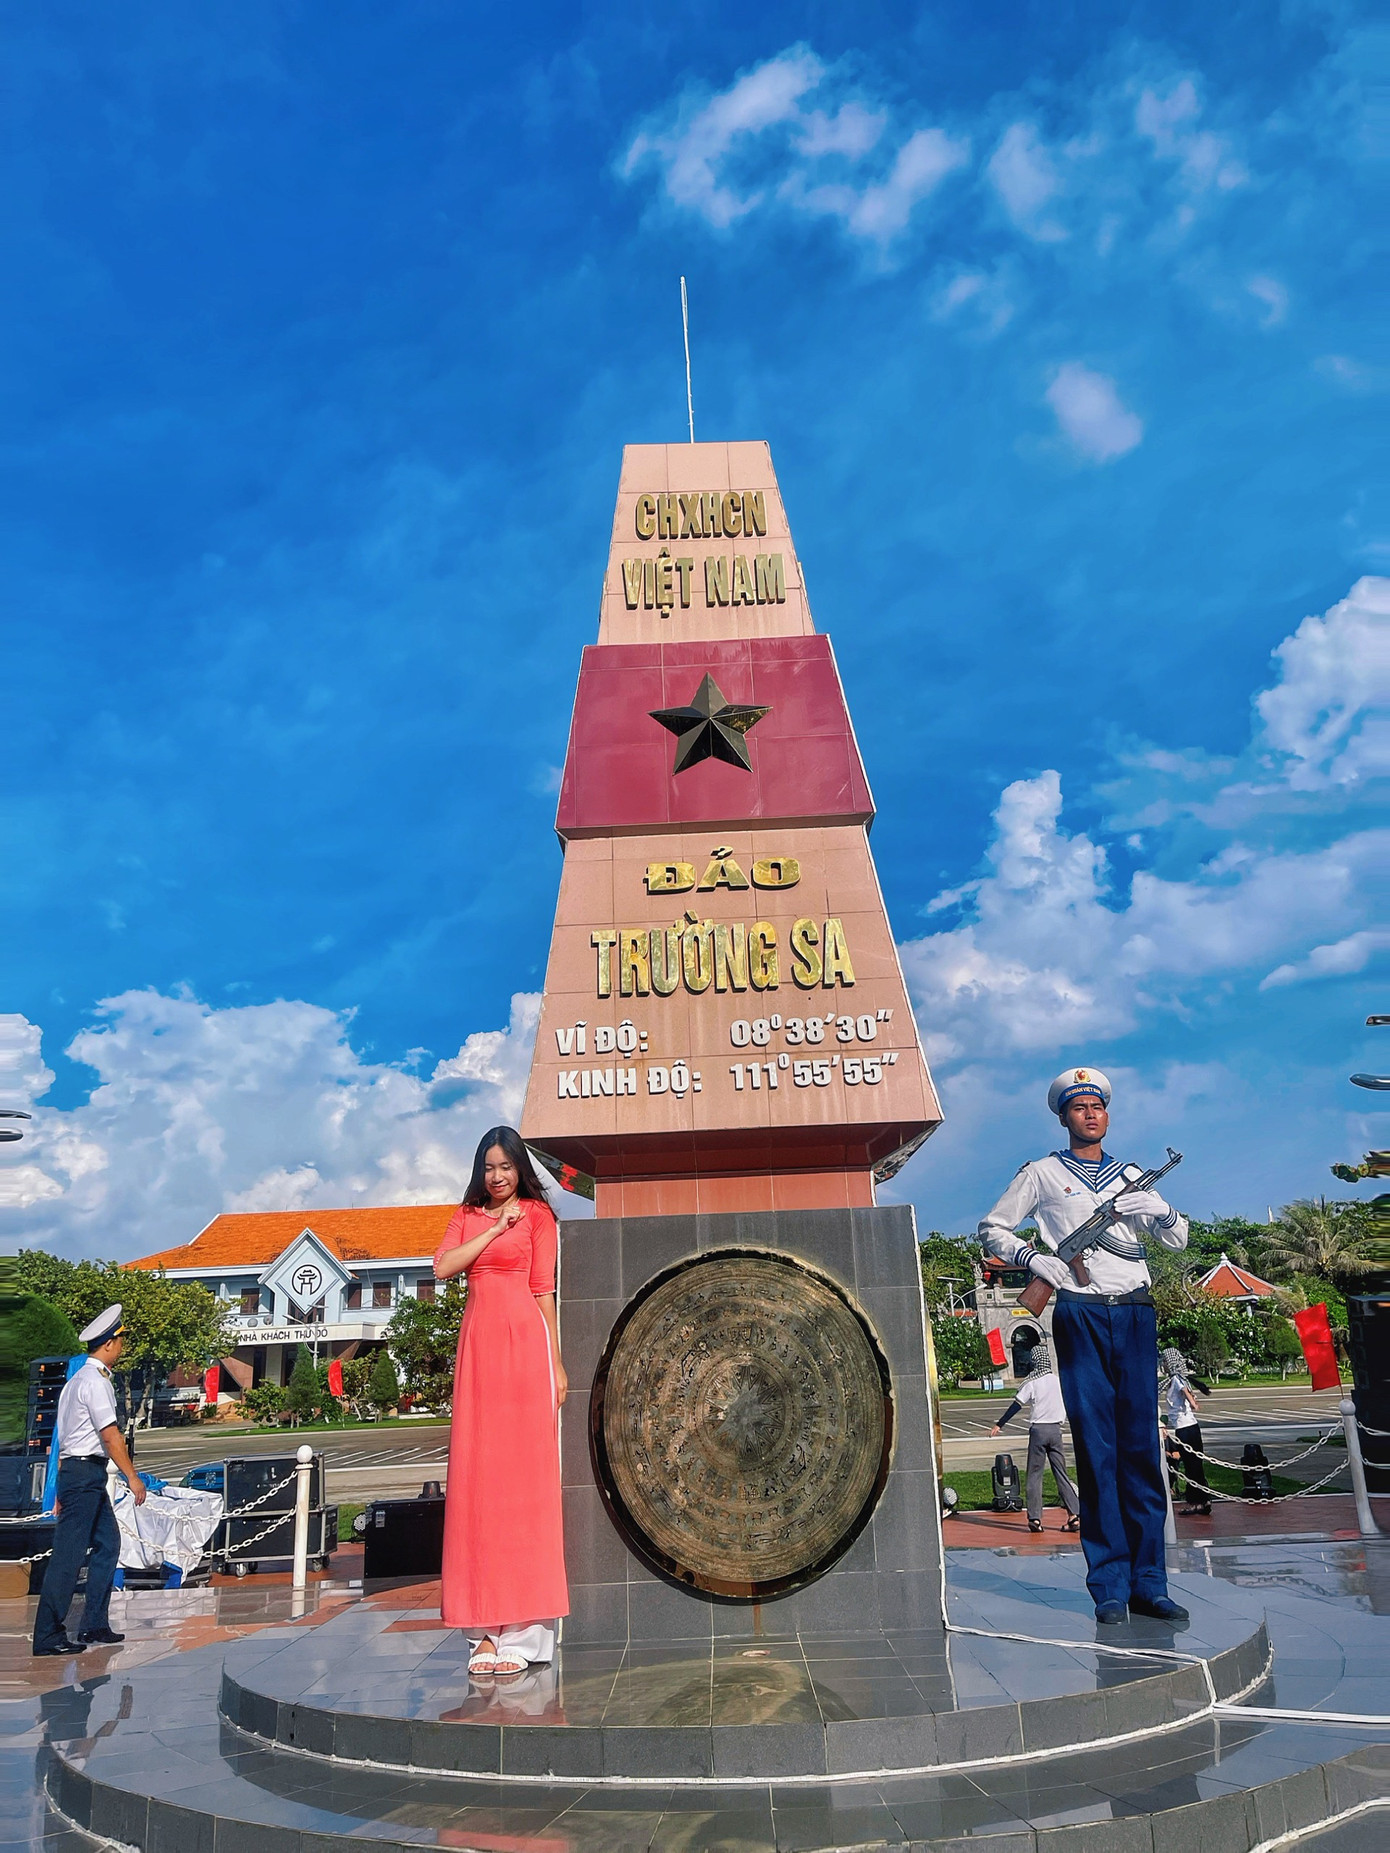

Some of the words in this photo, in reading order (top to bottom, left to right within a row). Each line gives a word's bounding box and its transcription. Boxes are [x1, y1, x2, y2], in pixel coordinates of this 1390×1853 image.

[635, 491, 767, 540] CHXHCN
[621, 547, 694, 618] VIỆT
[704, 553, 785, 608] NAM
[643, 846, 801, 895] ĐẢO
[591, 910, 779, 998] TRƯỜNG
[791, 918, 855, 990] SA
[555, 1020, 587, 1056] VĨ
[595, 1019, 649, 1058] ĐỘ:
[558, 1068, 636, 1099] KINH
[647, 1059, 702, 1099] ĐỘ:
[261, 1330, 290, 1341] KHÁCH
